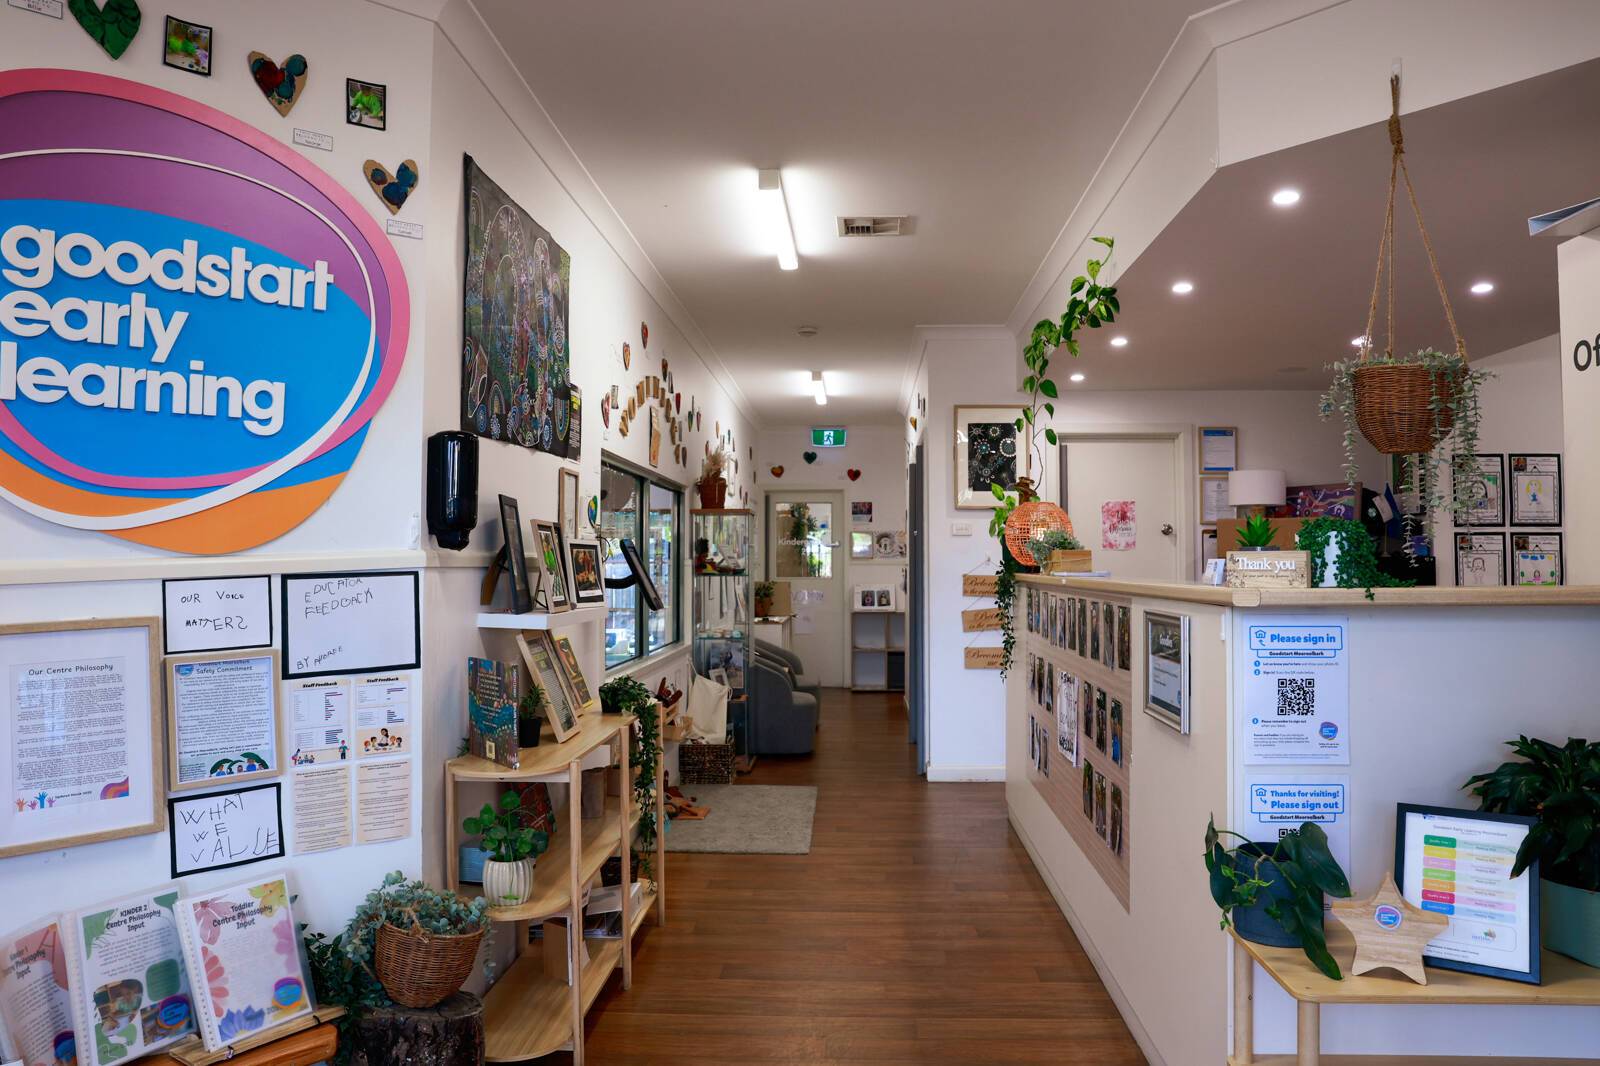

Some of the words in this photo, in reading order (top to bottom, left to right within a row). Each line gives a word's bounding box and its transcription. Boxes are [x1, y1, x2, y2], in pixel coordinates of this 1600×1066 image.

[1, 224, 334, 310] goodstart
[0, 290, 188, 363] early
[0, 341, 286, 436] learning
[1236, 557, 1271, 570] Thank
[1273, 559, 1296, 573] you
[181, 593, 200, 603] OUR
[1270, 633, 1301, 643] Please
[1303, 633, 1324, 645] sign
[1326, 633, 1336, 643] in
[28, 668, 43, 676] Our
[46, 667, 73, 675] Centre
[75, 663, 114, 672] Philosophy
[297, 656, 309, 670] BY
[196, 667, 215, 675] Safety
[216, 665, 253, 673] Commitment
[1309, 790, 1340, 798] visiting!
[180, 793, 243, 825] WHAT
[1271, 801, 1299, 809] Please
[1301, 801, 1321, 811] sign
[191, 827, 280, 863] VALUE
[120, 905, 143, 917] KINDER
[231, 901, 254, 912] Toddler
[106, 918, 128, 930] Centre
[128, 909, 161, 923] Philosophy
[212, 915, 236, 927] Centre
[237, 905, 273, 920] Philosophy
[127, 921, 145, 932] Input
[236, 918, 255, 929] Input
